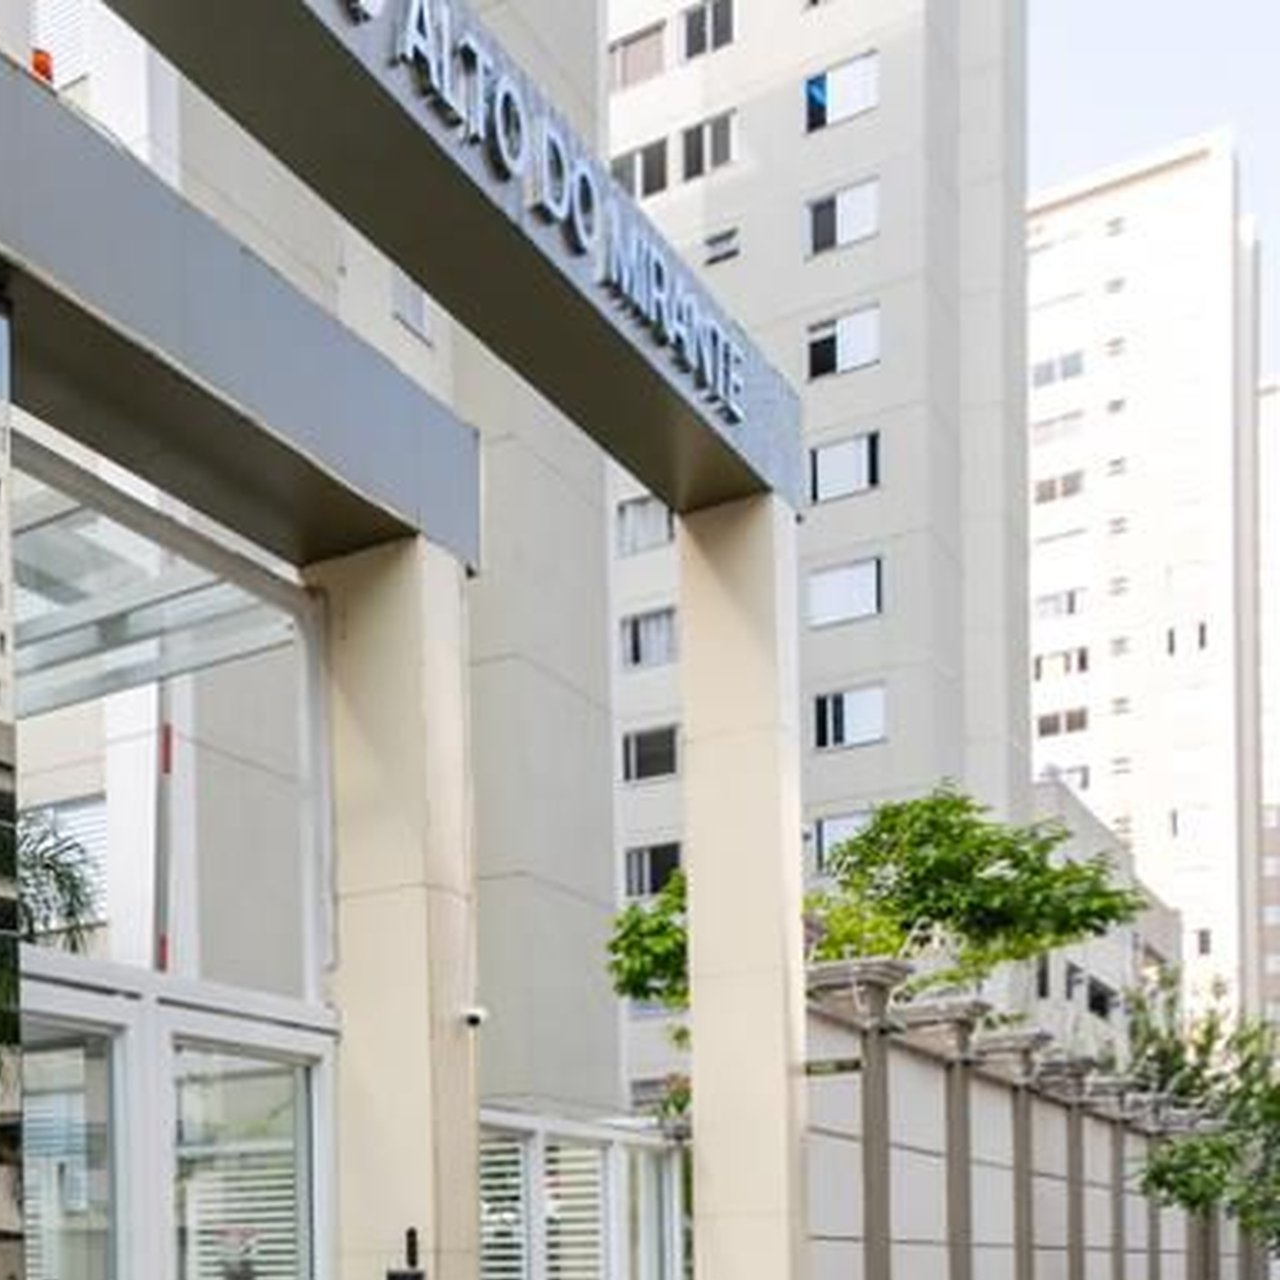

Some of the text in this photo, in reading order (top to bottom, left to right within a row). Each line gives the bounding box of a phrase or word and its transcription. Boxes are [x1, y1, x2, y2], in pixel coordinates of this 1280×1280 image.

[392, 0, 745, 423] ALTO DO MIRANTE
